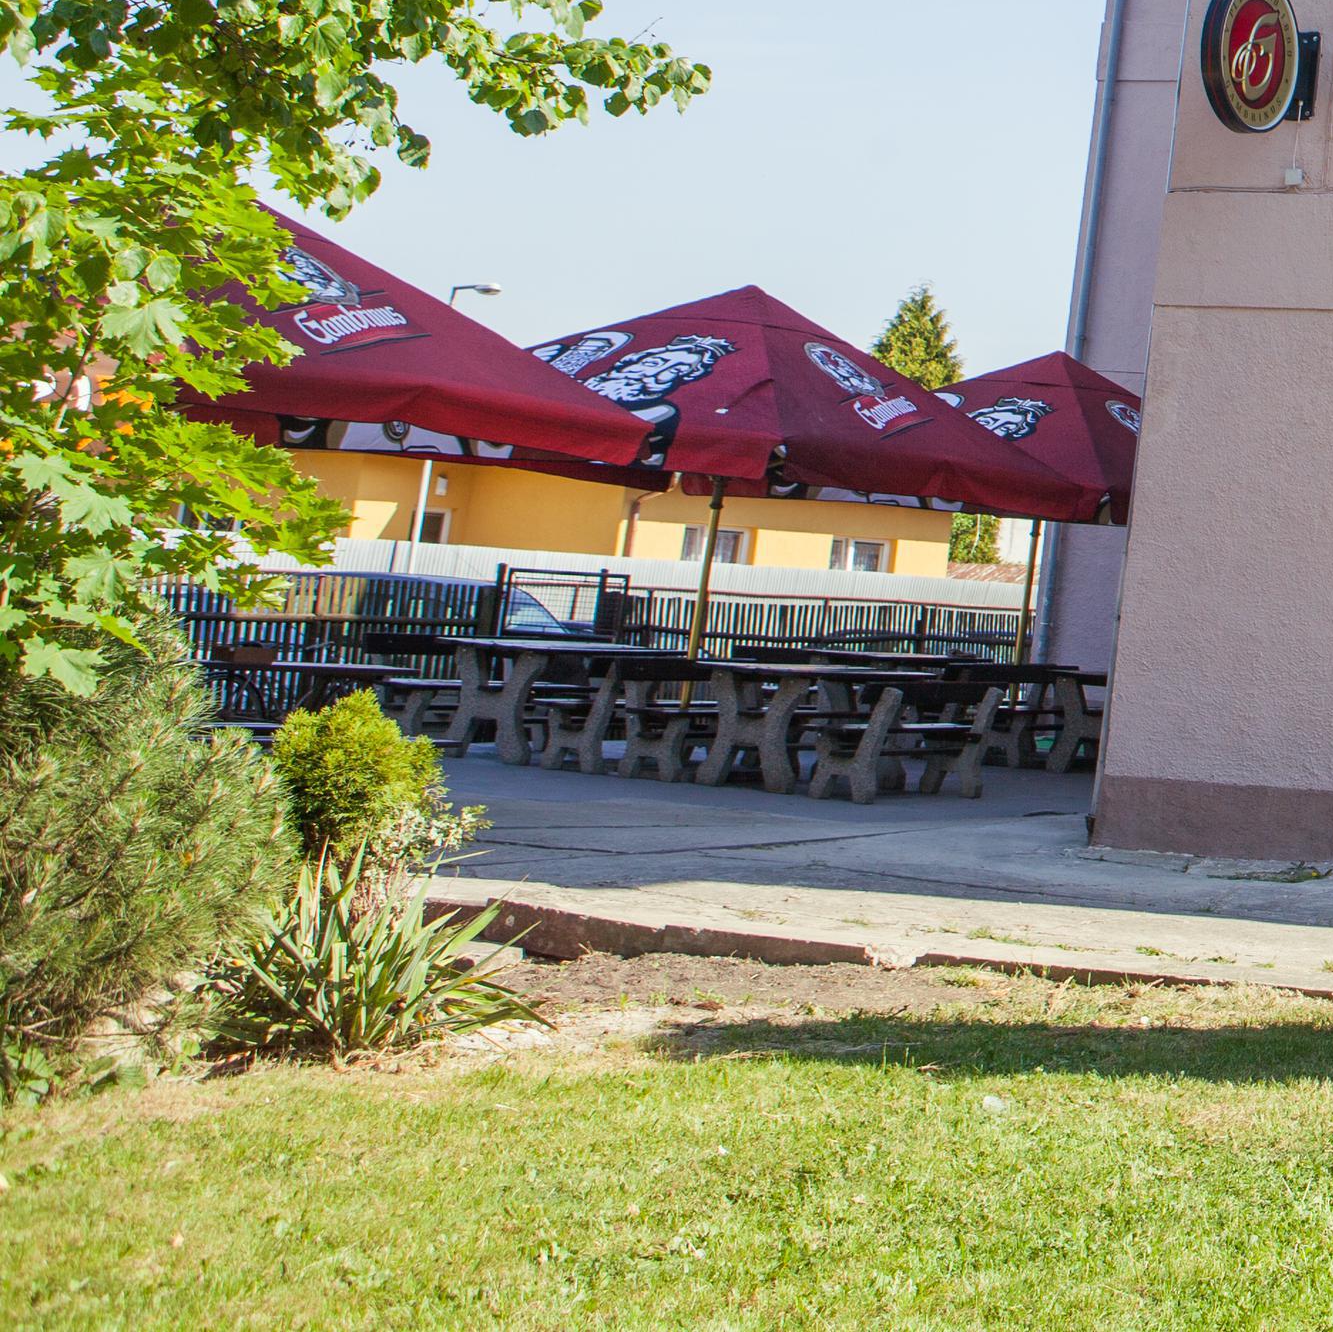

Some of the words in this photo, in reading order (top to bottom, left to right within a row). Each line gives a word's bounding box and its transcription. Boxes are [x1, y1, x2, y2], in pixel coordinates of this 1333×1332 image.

[1225, 79, 1282, 122] GAMBRINUS
[293, 304, 408, 344] Gambrinus
[853, 396, 918, 429] Gambrinus
